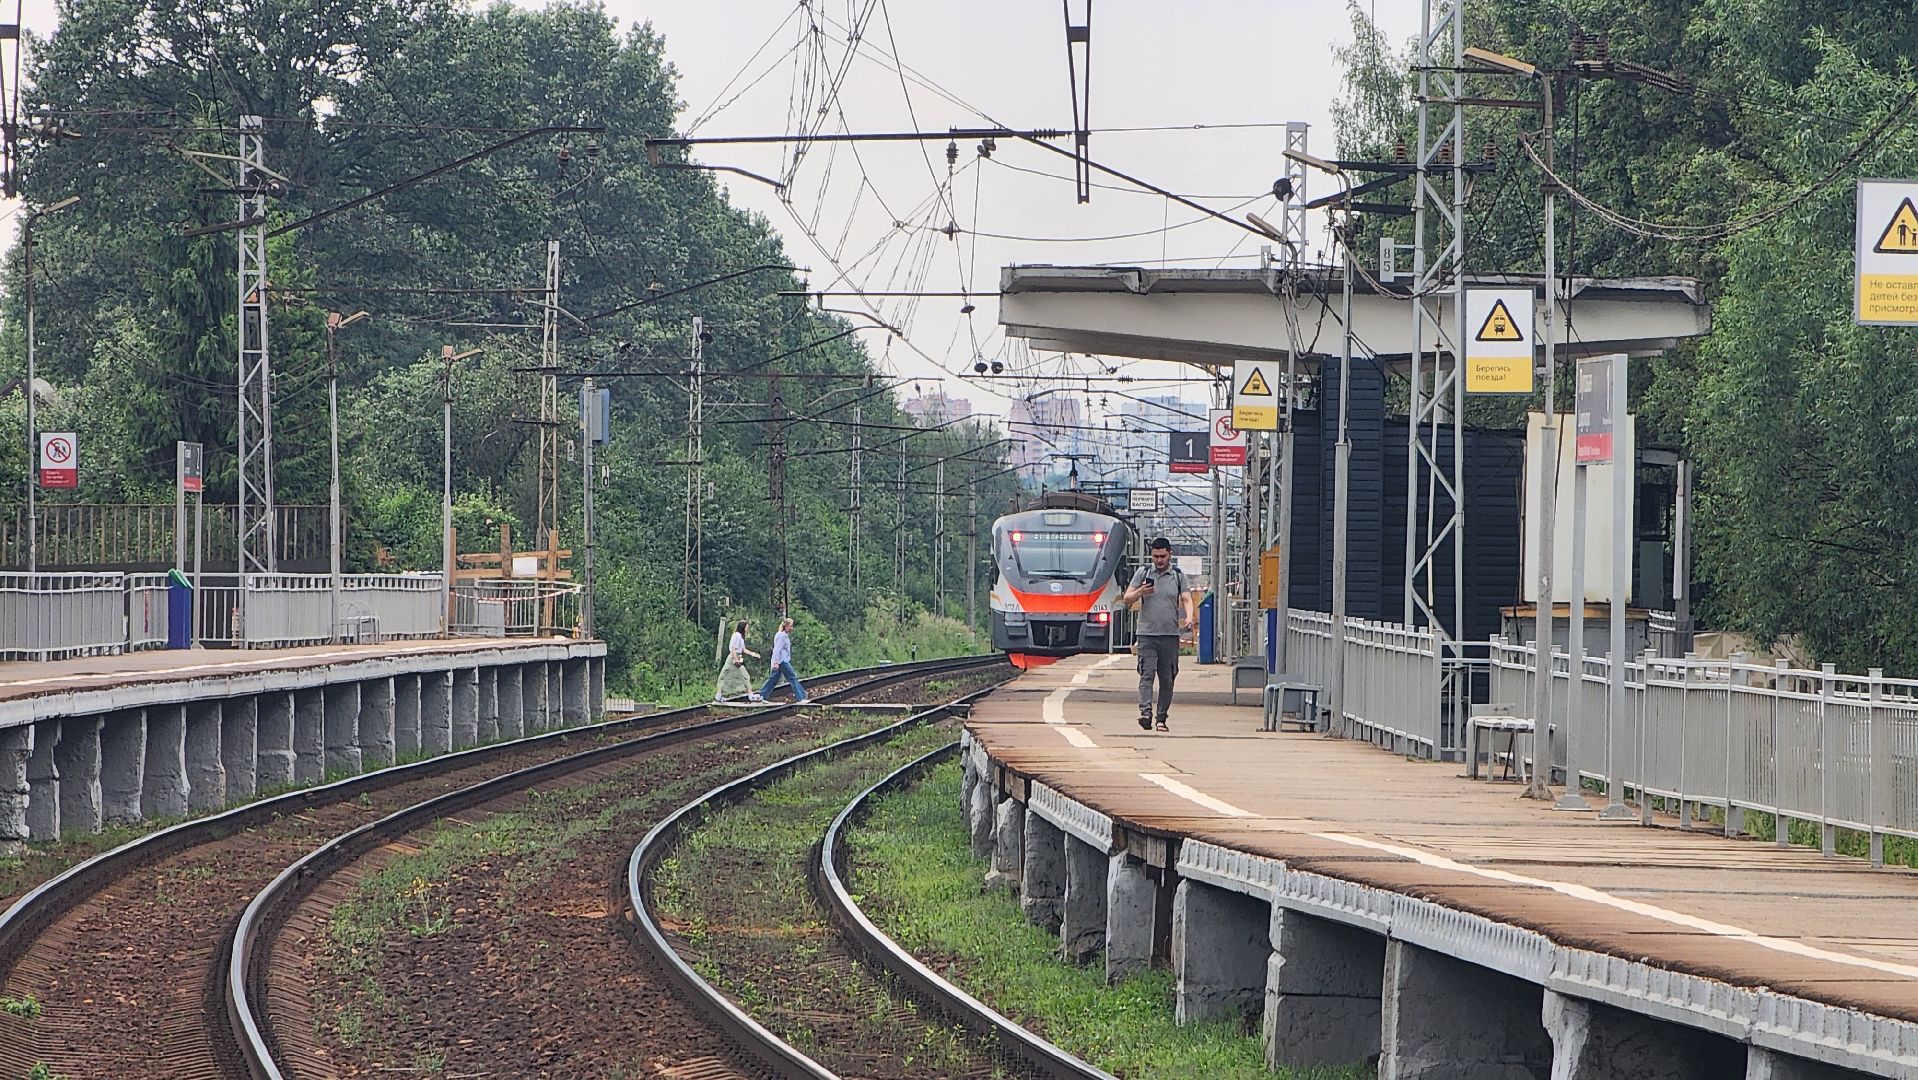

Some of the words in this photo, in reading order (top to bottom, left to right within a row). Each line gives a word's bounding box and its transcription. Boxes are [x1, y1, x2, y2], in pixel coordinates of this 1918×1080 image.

[1383, 247, 1391, 272] 85
[1870, 280, 1883, 289] Не
[1870, 292, 1898, 301] детей
[1901, 292, 1918, 301] без
[1475, 364, 1511, 373] Берегись
[1185, 438, 1193, 458] 1
